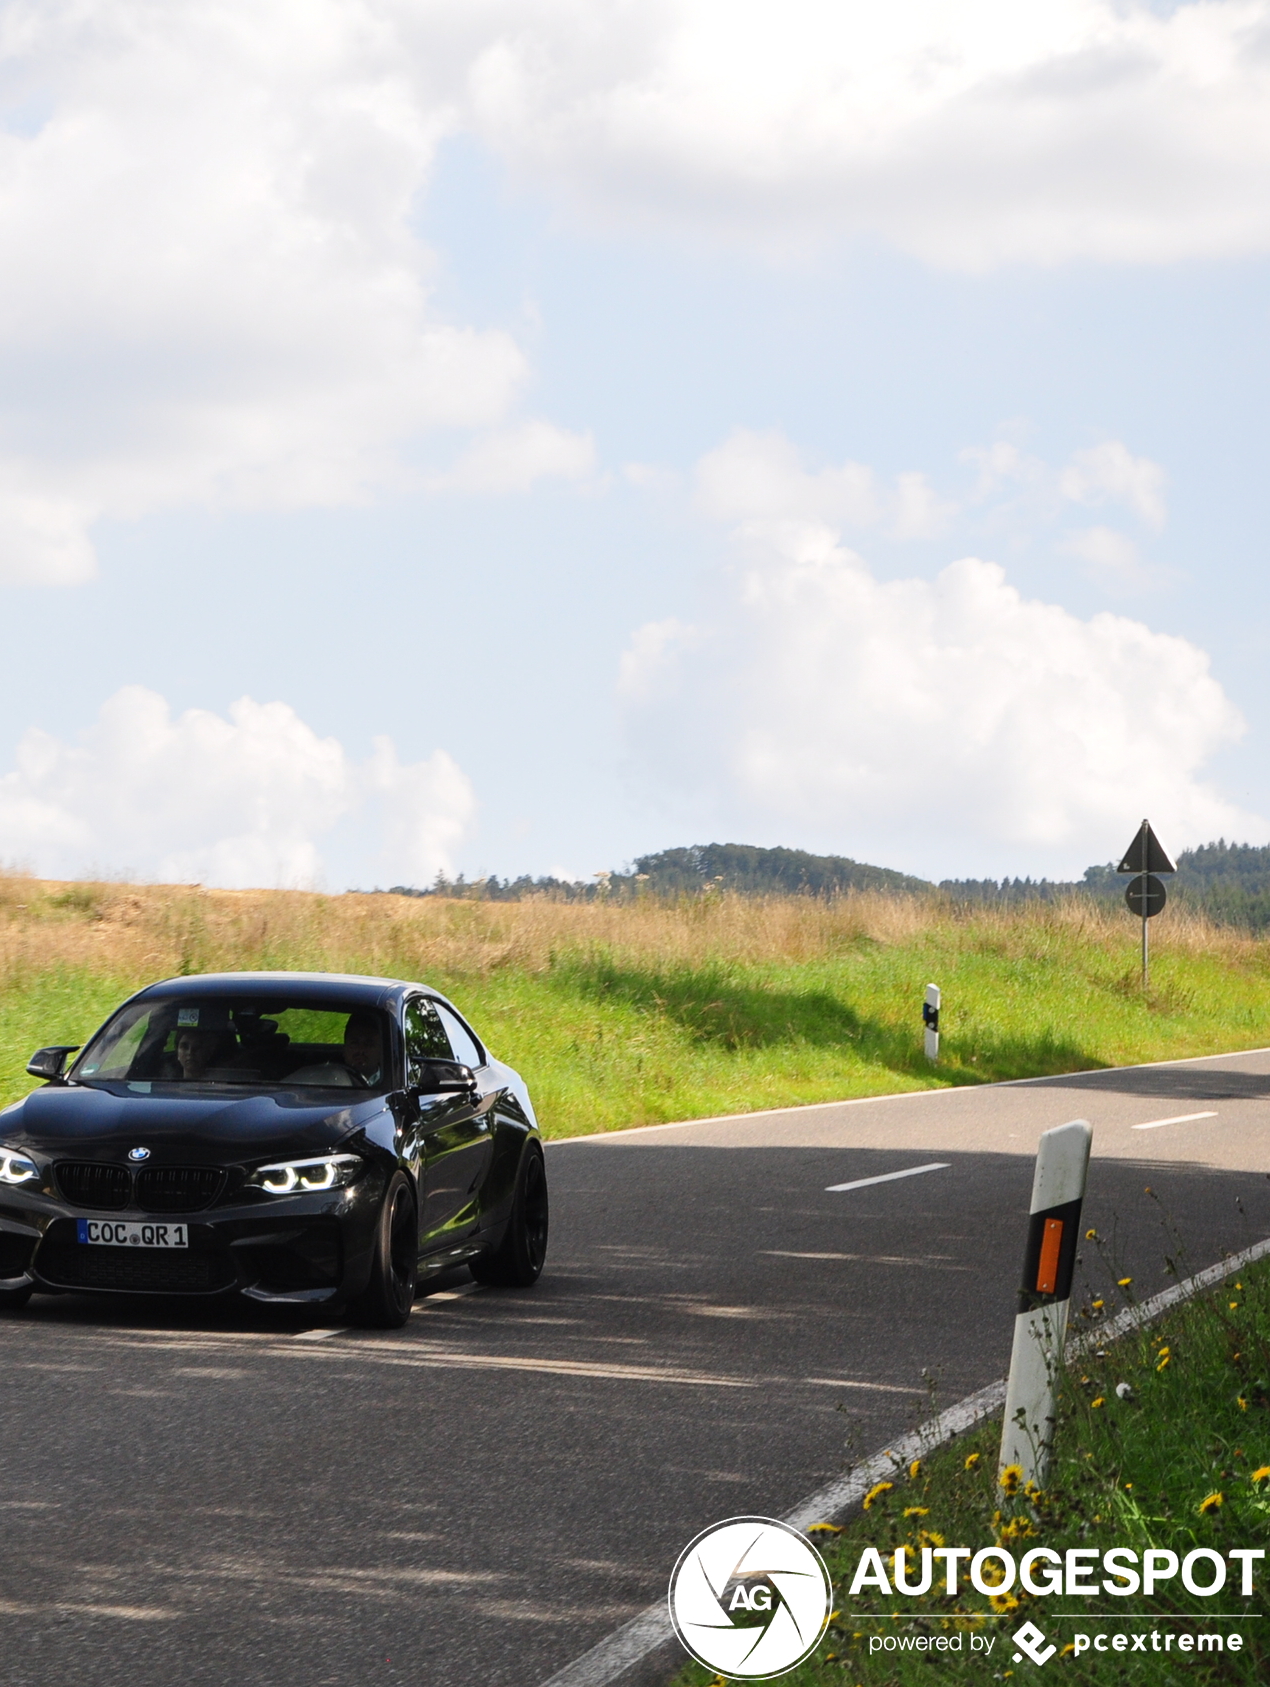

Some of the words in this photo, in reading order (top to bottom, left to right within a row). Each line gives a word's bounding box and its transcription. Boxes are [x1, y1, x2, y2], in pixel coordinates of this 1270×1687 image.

[88, 1223, 127, 1243] COC
[141, 1225, 169, 1245] QR
[174, 1226, 187, 1246] 1
